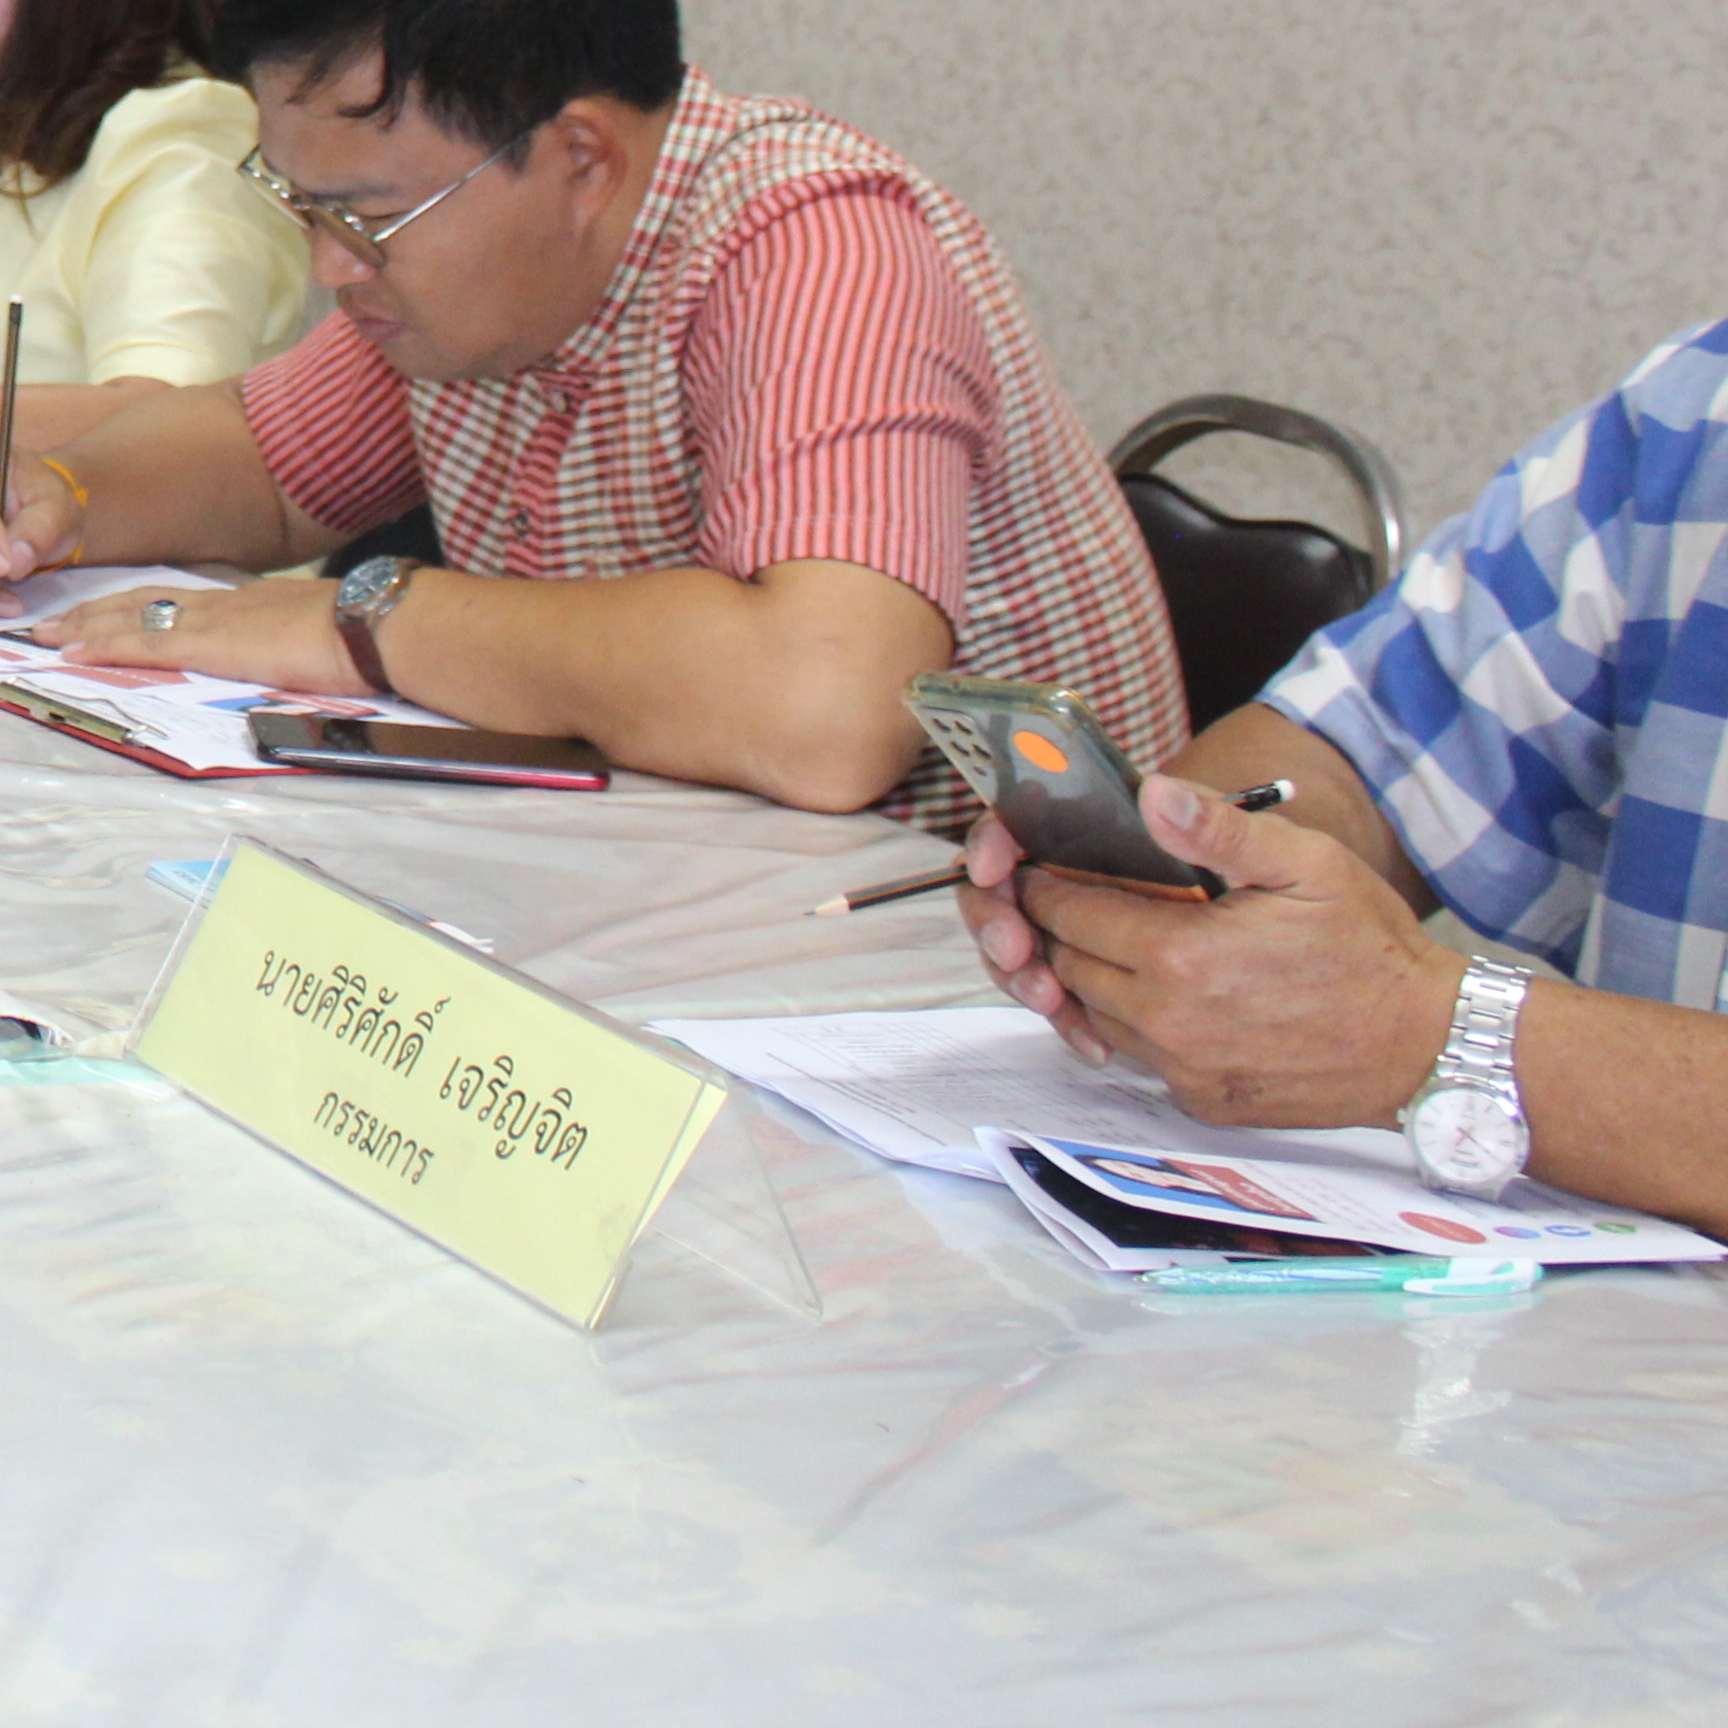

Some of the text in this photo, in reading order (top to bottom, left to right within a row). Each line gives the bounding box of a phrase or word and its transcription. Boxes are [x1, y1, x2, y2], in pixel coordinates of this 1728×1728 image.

[255, 950, 588, 1171] นายศิริศักดิ์ เจริญจิต
[313, 1091, 435, 1185] กรรมการ
